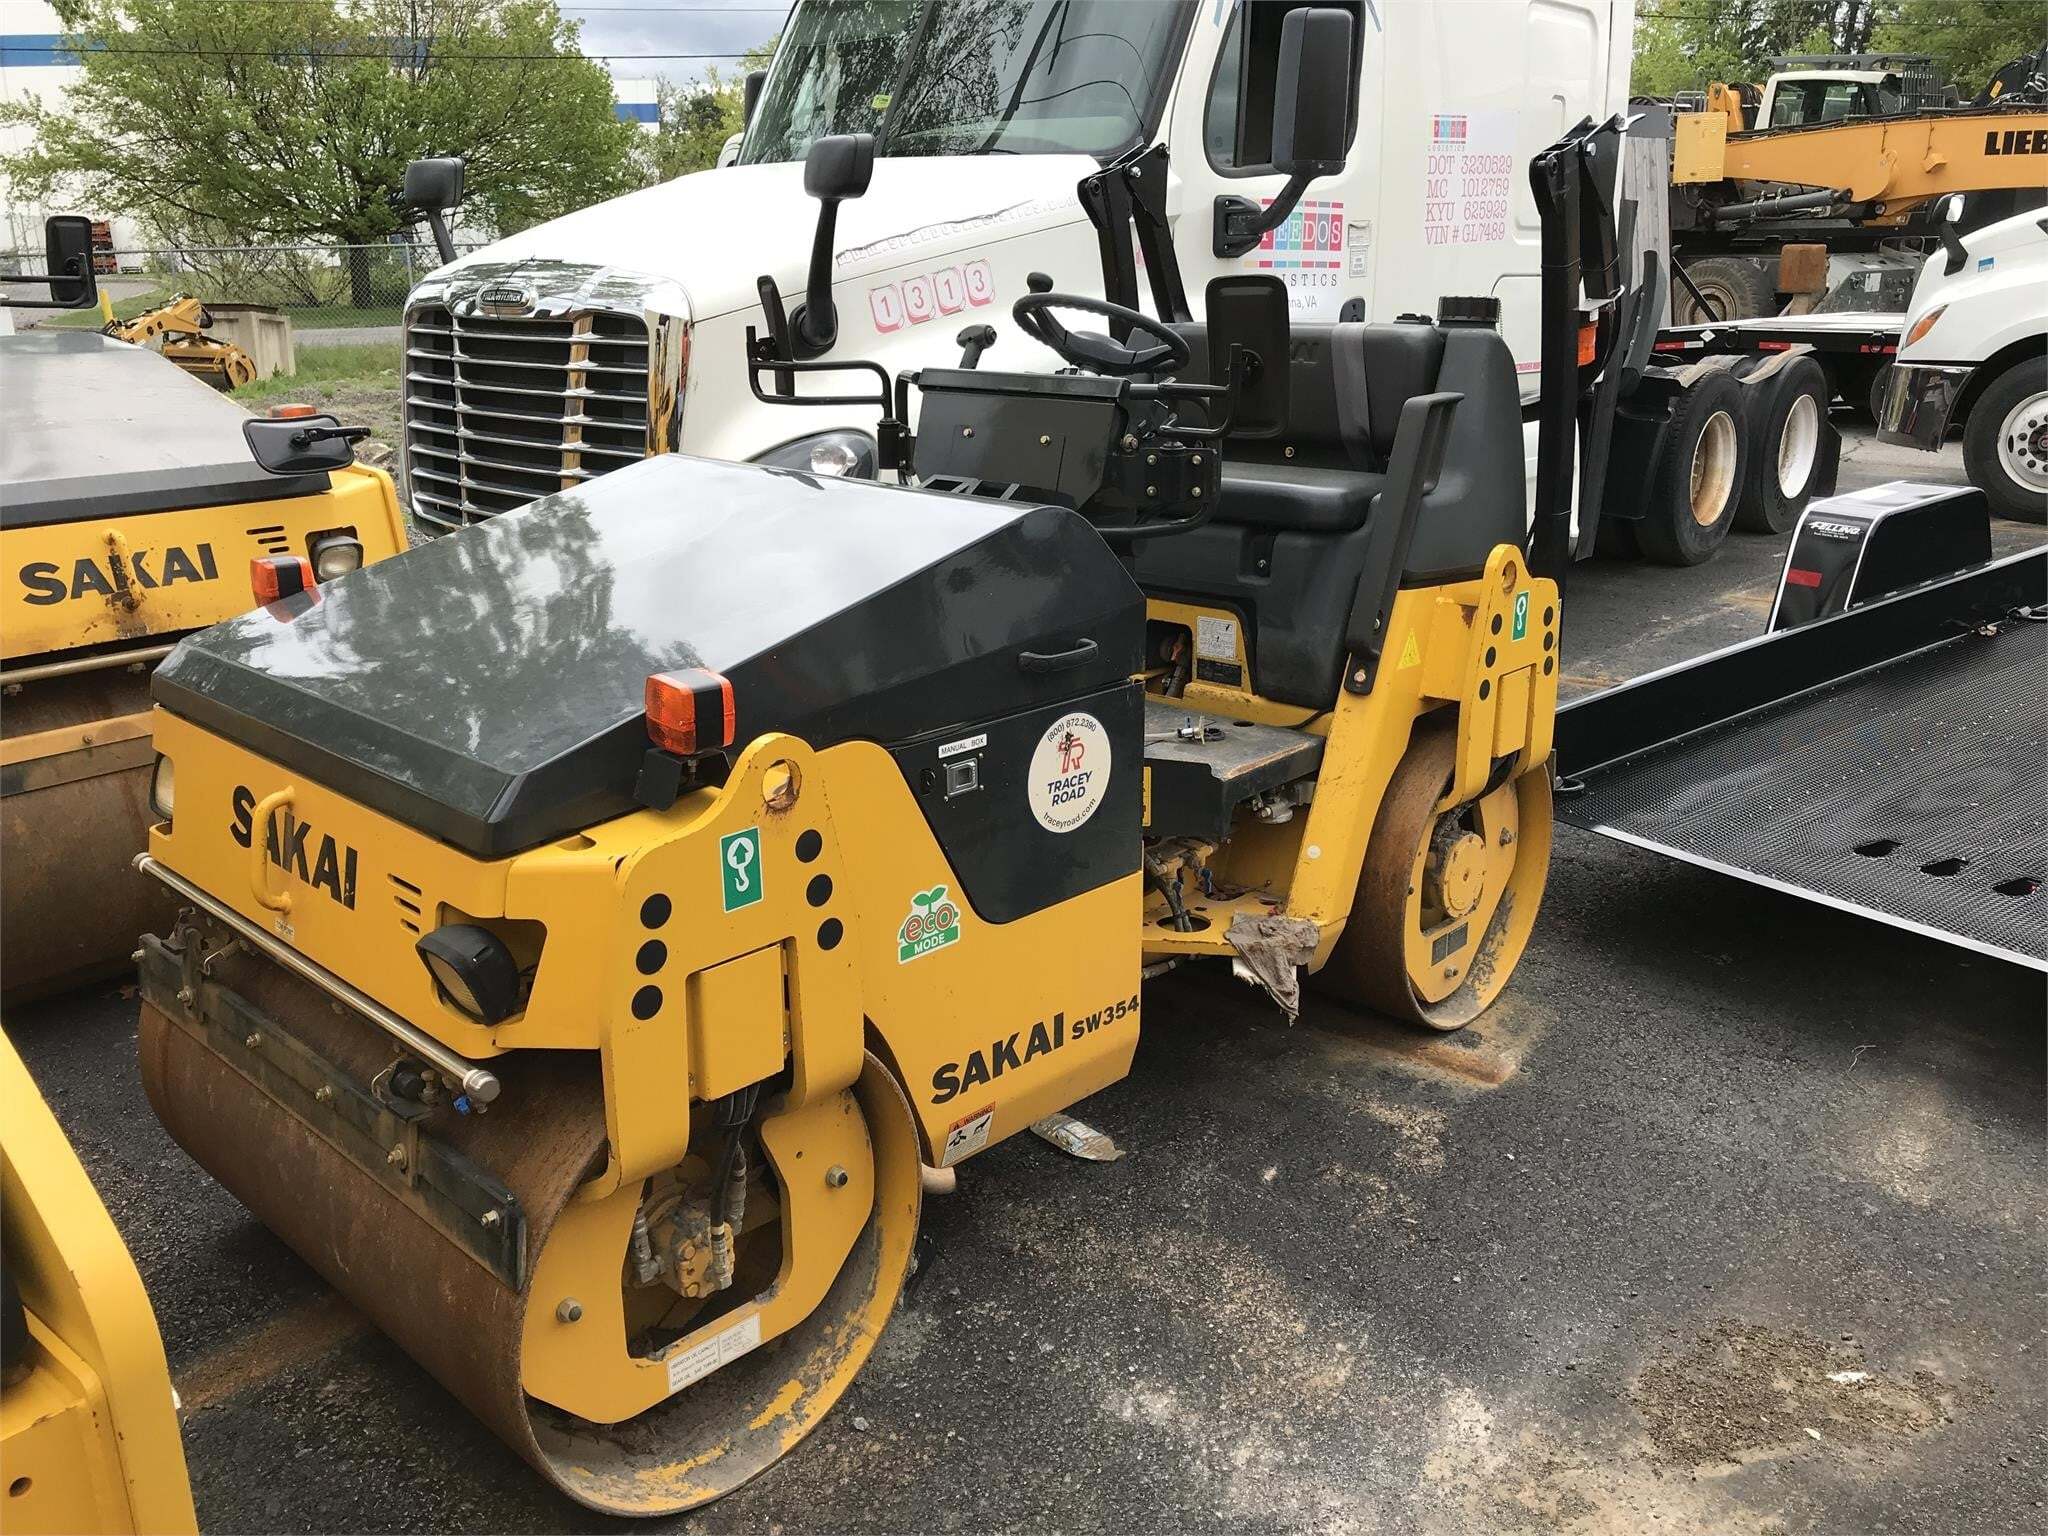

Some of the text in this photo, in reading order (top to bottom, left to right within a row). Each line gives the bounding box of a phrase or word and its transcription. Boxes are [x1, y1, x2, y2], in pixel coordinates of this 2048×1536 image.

[1985, 130, 2048, 155] LIEB
[1427, 155, 1512, 174] DOT 3230529
[1426, 178, 1510, 198] MC 1012759
[1425, 200, 1507, 222] KYU 625929
[1424, 225, 1449, 245] VIN
[1282, 273, 1338, 287] ISTICS
[19, 543, 219, 606] SAKAI
[1047, 724, 1065, 742] (800)
[941, 742, 967, 754] MANUAL
[1047, 770, 1093, 795] TRACEY
[1052, 787, 1086, 807] ROAD
[1043, 798, 1096, 829] traceyroad.com
[230, 785, 358, 911] SAKAI
[904, 904, 955, 943] eco
[914, 933, 945, 954] MODE
[930, 994, 1139, 1105] SAKAI SW354
